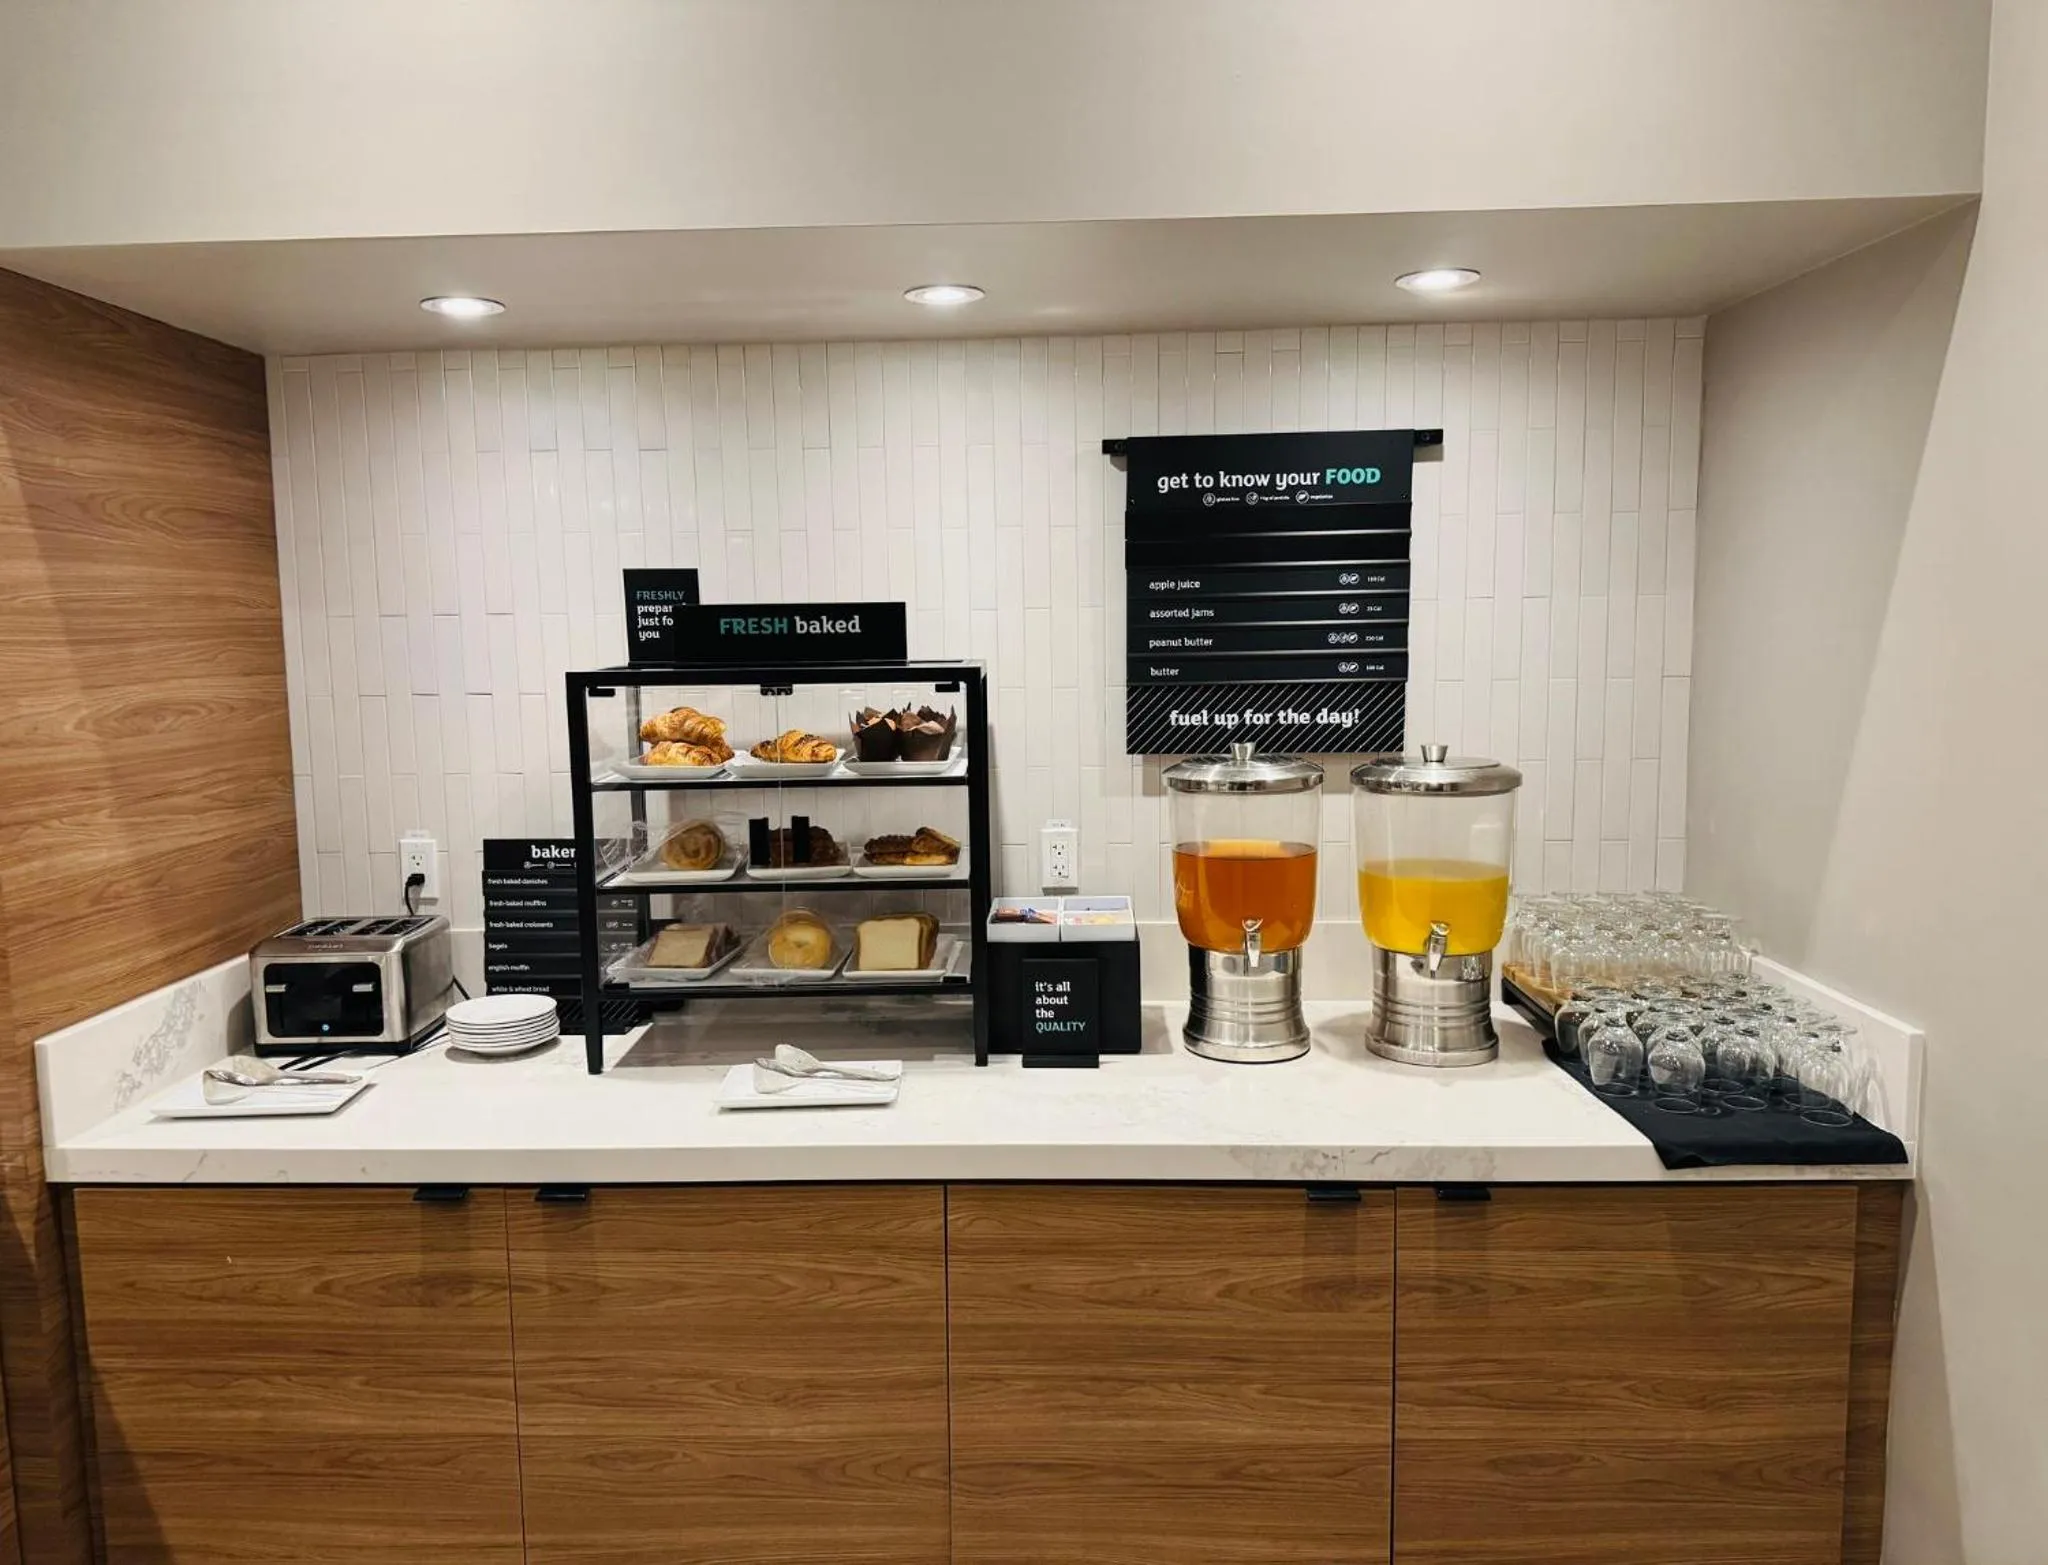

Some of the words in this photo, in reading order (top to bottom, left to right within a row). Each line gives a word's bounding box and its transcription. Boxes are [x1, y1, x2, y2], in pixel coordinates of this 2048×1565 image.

[1157, 473, 1189, 493] get
[1194, 473, 1214, 488] to
[1219, 470, 1270, 488] know
[1275, 471, 1320, 491] your
[1325, 467, 1382, 485] FOOD
[1149, 580, 1175, 590] apple
[1177, 580, 1201, 590] juice
[636, 591, 685, 600] FRESHLY
[636, 602, 674, 615] prepar
[1149, 608, 1189, 618] assorted
[1191, 608, 1215, 619] jams
[637, 615, 660, 628] just
[662, 615, 674, 626] fo
[719, 617, 788, 635] FRESH
[794, 616, 861, 634] baked
[638, 630, 661, 642] you
[1149, 638, 1182, 649] peanut
[1184, 637, 1213, 646] butter
[1150, 667, 1180, 676] butter
[1169, 709, 1209, 726] fuel
[1214, 711, 1239, 729] up
[1244, 708, 1273, 725] for
[1278, 708, 1310, 724] the
[1316, 708, 1360, 728] day!
[531, 844, 576, 858] baker
[1035, 981, 1053, 992] it's
[1056, 981, 1071, 992] all
[1035, 994, 1068, 1005] about
[1035, 1007, 1055, 1018] the
[1035, 1021, 1086, 1034] QUALITY
